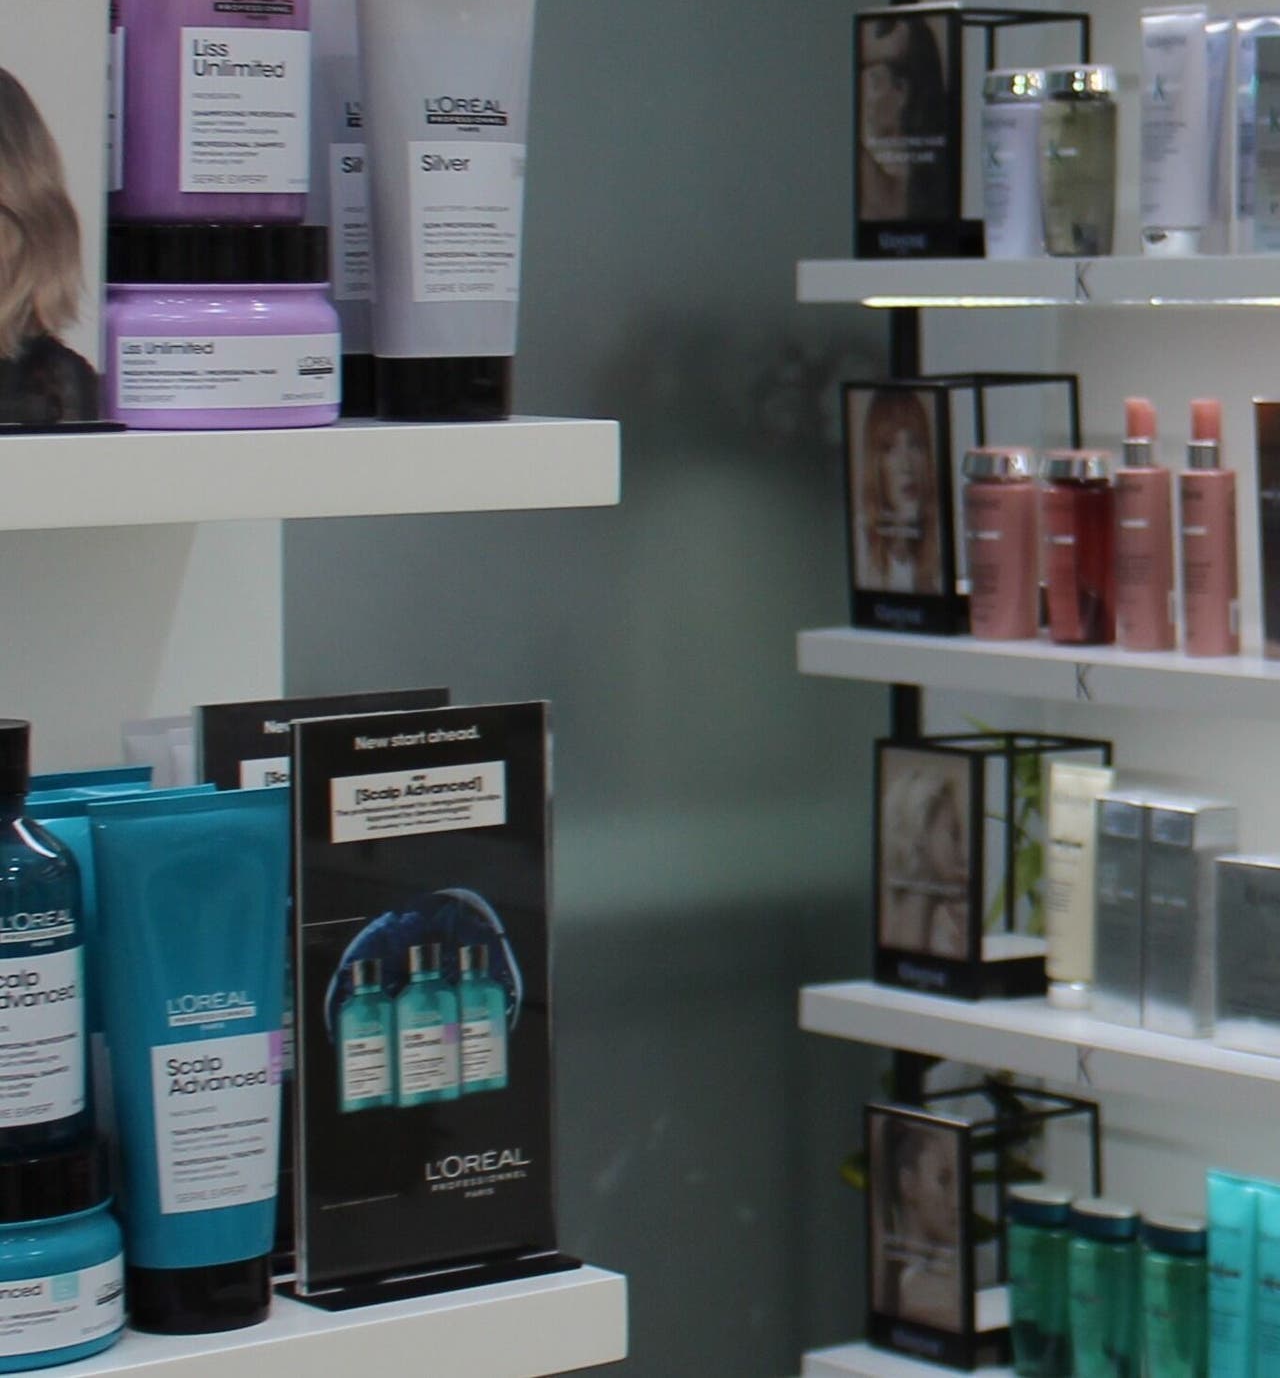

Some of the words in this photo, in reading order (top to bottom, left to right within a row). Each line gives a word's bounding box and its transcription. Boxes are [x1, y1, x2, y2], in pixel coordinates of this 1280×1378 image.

[193, 39, 229, 58] Liss
[193, 59, 285, 79] Unlimited
[425, 96, 508, 115] L'ORÉAL
[421, 154, 471, 172] Silver
[146, 341, 215, 355] Unlimited
[354, 735, 389, 751] New
[391, 730, 427, 747] start
[428, 724, 481, 743] ahead.
[0, 983, 77, 1010] dvanced
[167, 1054, 224, 1078] Scalp
[168, 1068, 270, 1097] Advanced
[424, 1147, 532, 1181] L'ORÉAL
